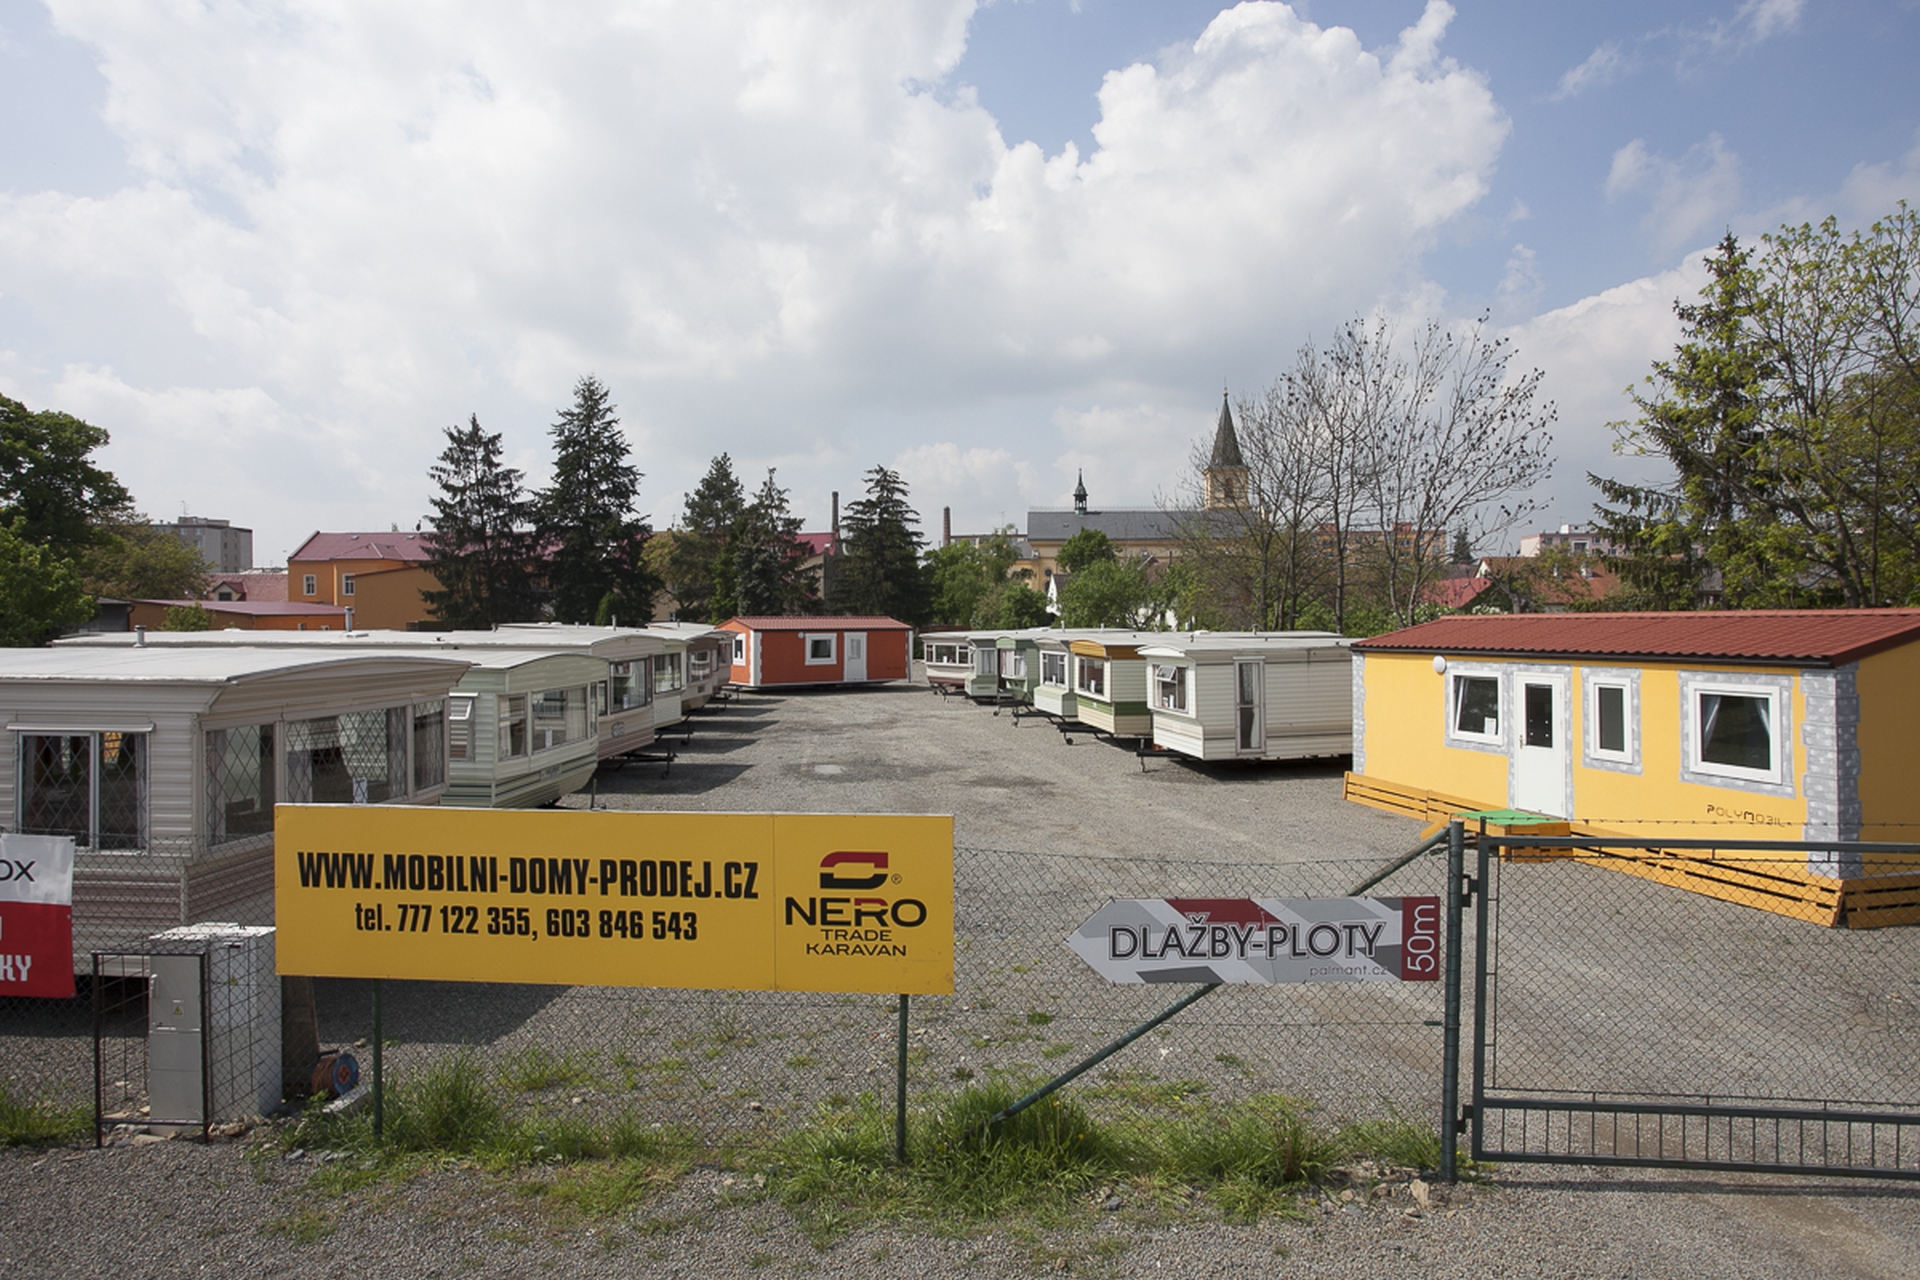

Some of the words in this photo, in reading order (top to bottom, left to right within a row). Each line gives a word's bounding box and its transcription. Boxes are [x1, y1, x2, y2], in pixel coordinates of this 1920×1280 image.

[297, 851, 759, 899] WWW.MOBILNI-DOMY-PRODEJ.CZ
[355, 902, 391, 932] tel.
[397, 904, 432, 932] 777
[439, 905, 479, 934] 122
[486, 906, 538, 941] 355,
[546, 908, 590, 938] 603
[599, 910, 643, 939] 846
[652, 911, 697, 940] 543
[785, 896, 927, 927] NERO
[806, 943, 907, 956] KARAVAN
[820, 929, 892, 941] TRADE
[1110, 914, 1385, 958] DLAŽBY-PLOTY
[1407, 904, 1435, 972] 50m
[1309, 965, 1388, 977] palmant.cz
